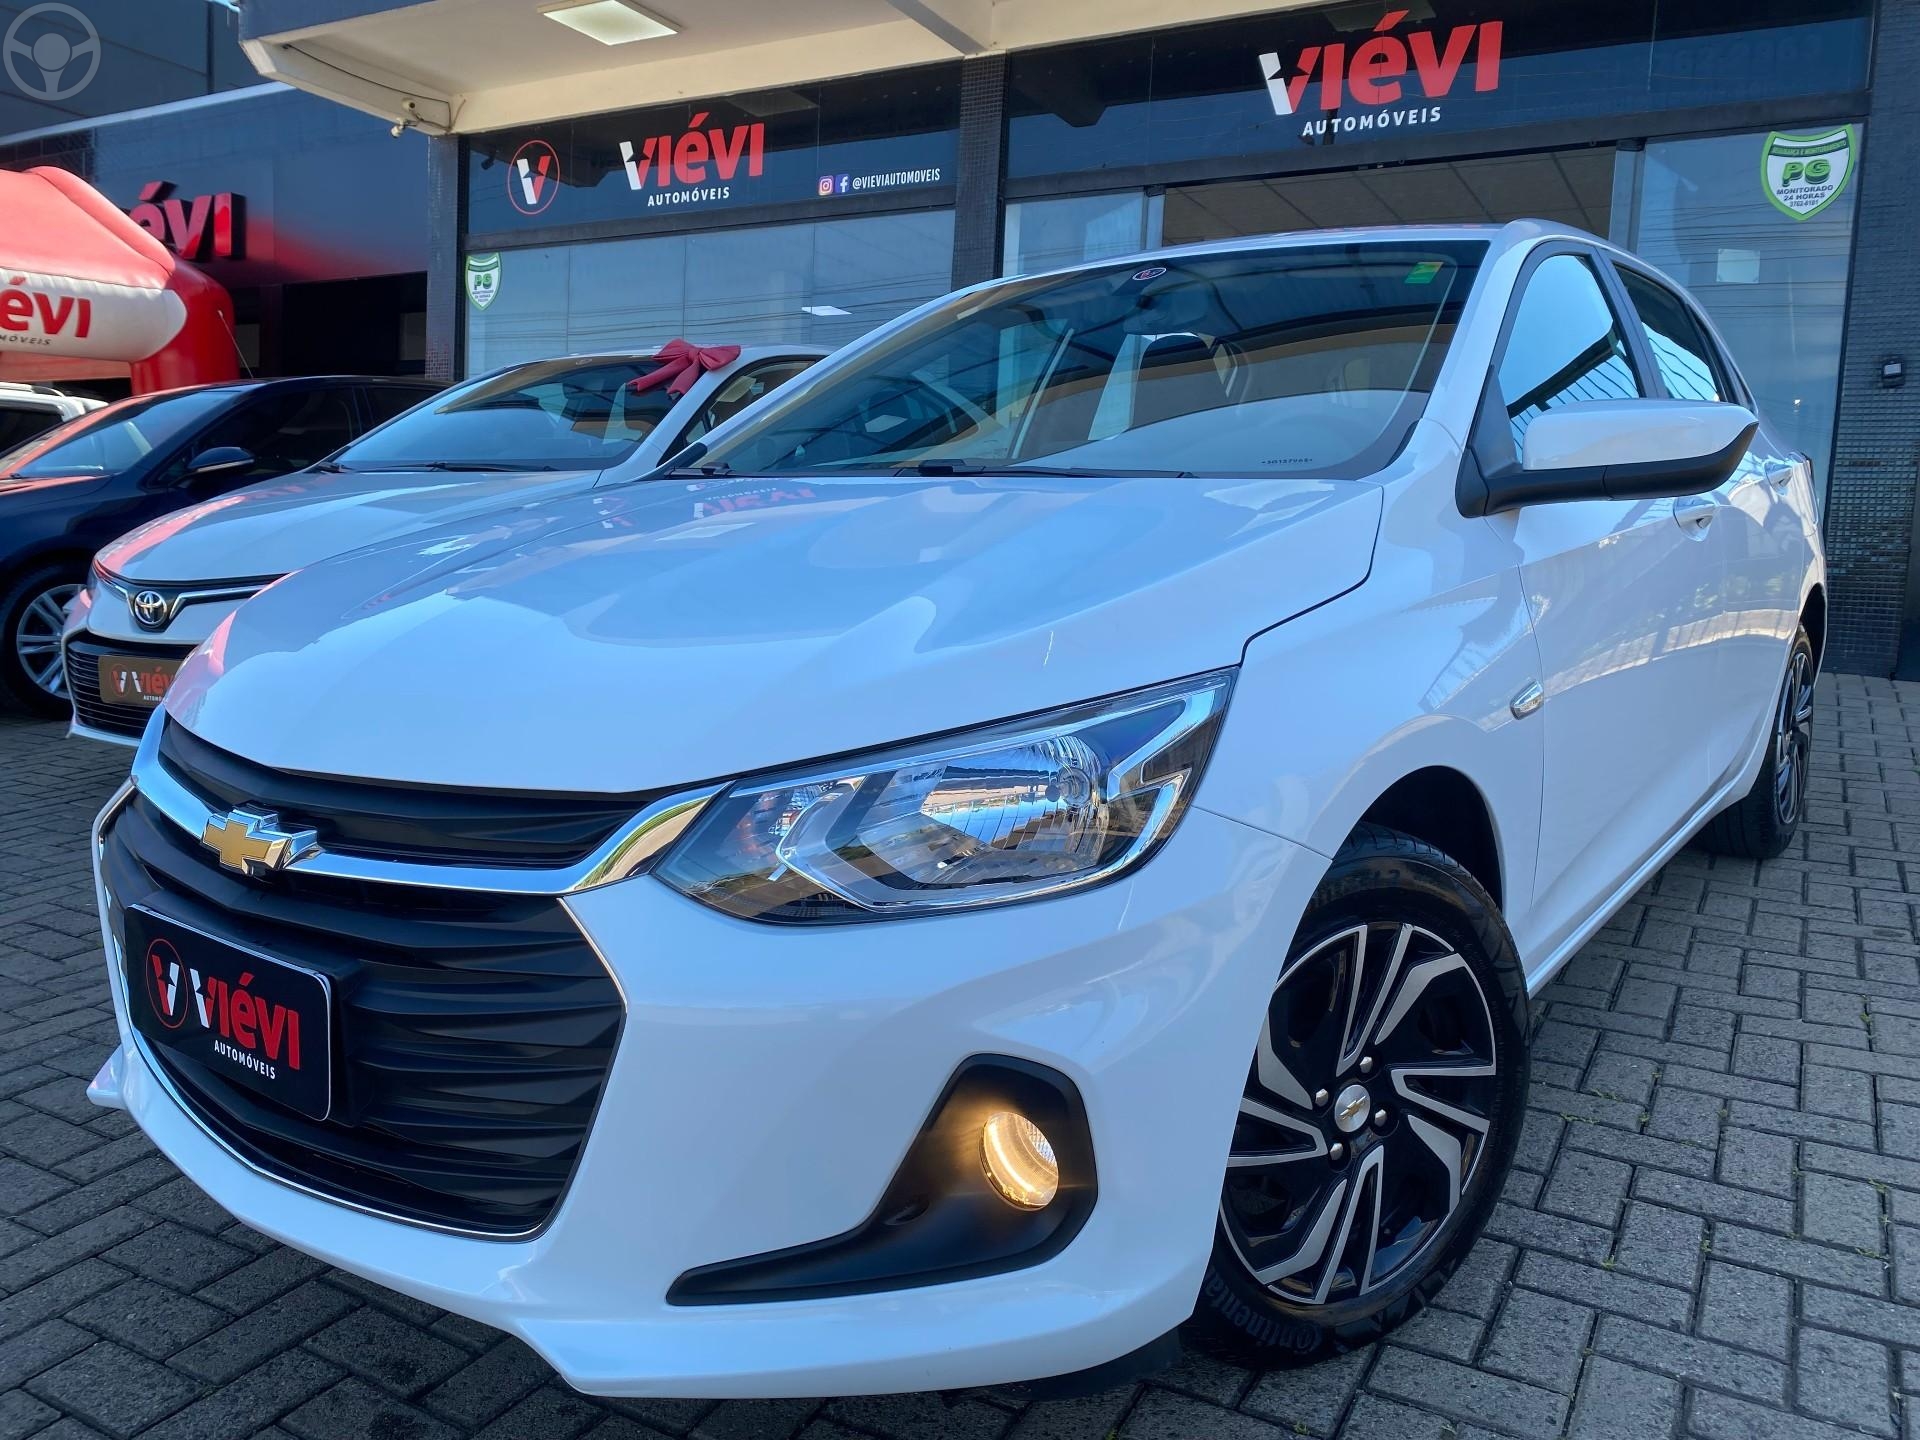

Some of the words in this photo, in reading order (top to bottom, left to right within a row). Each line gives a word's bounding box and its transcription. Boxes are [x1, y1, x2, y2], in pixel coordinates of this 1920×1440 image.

[1302, 107, 1441, 136] AUTOMÓVEIS
[852, 168, 941, 190] @VIEVIAUTOMOVEIS
[1782, 159, 1830, 187] PG
[648, 187, 730, 207] AUTOMÓVEIS
[1776, 184, 1834, 195] MONITORADO
[1796, 193, 1825, 201] HORAS
[214, 1039, 276, 1080] AUTOMÓVEIS
